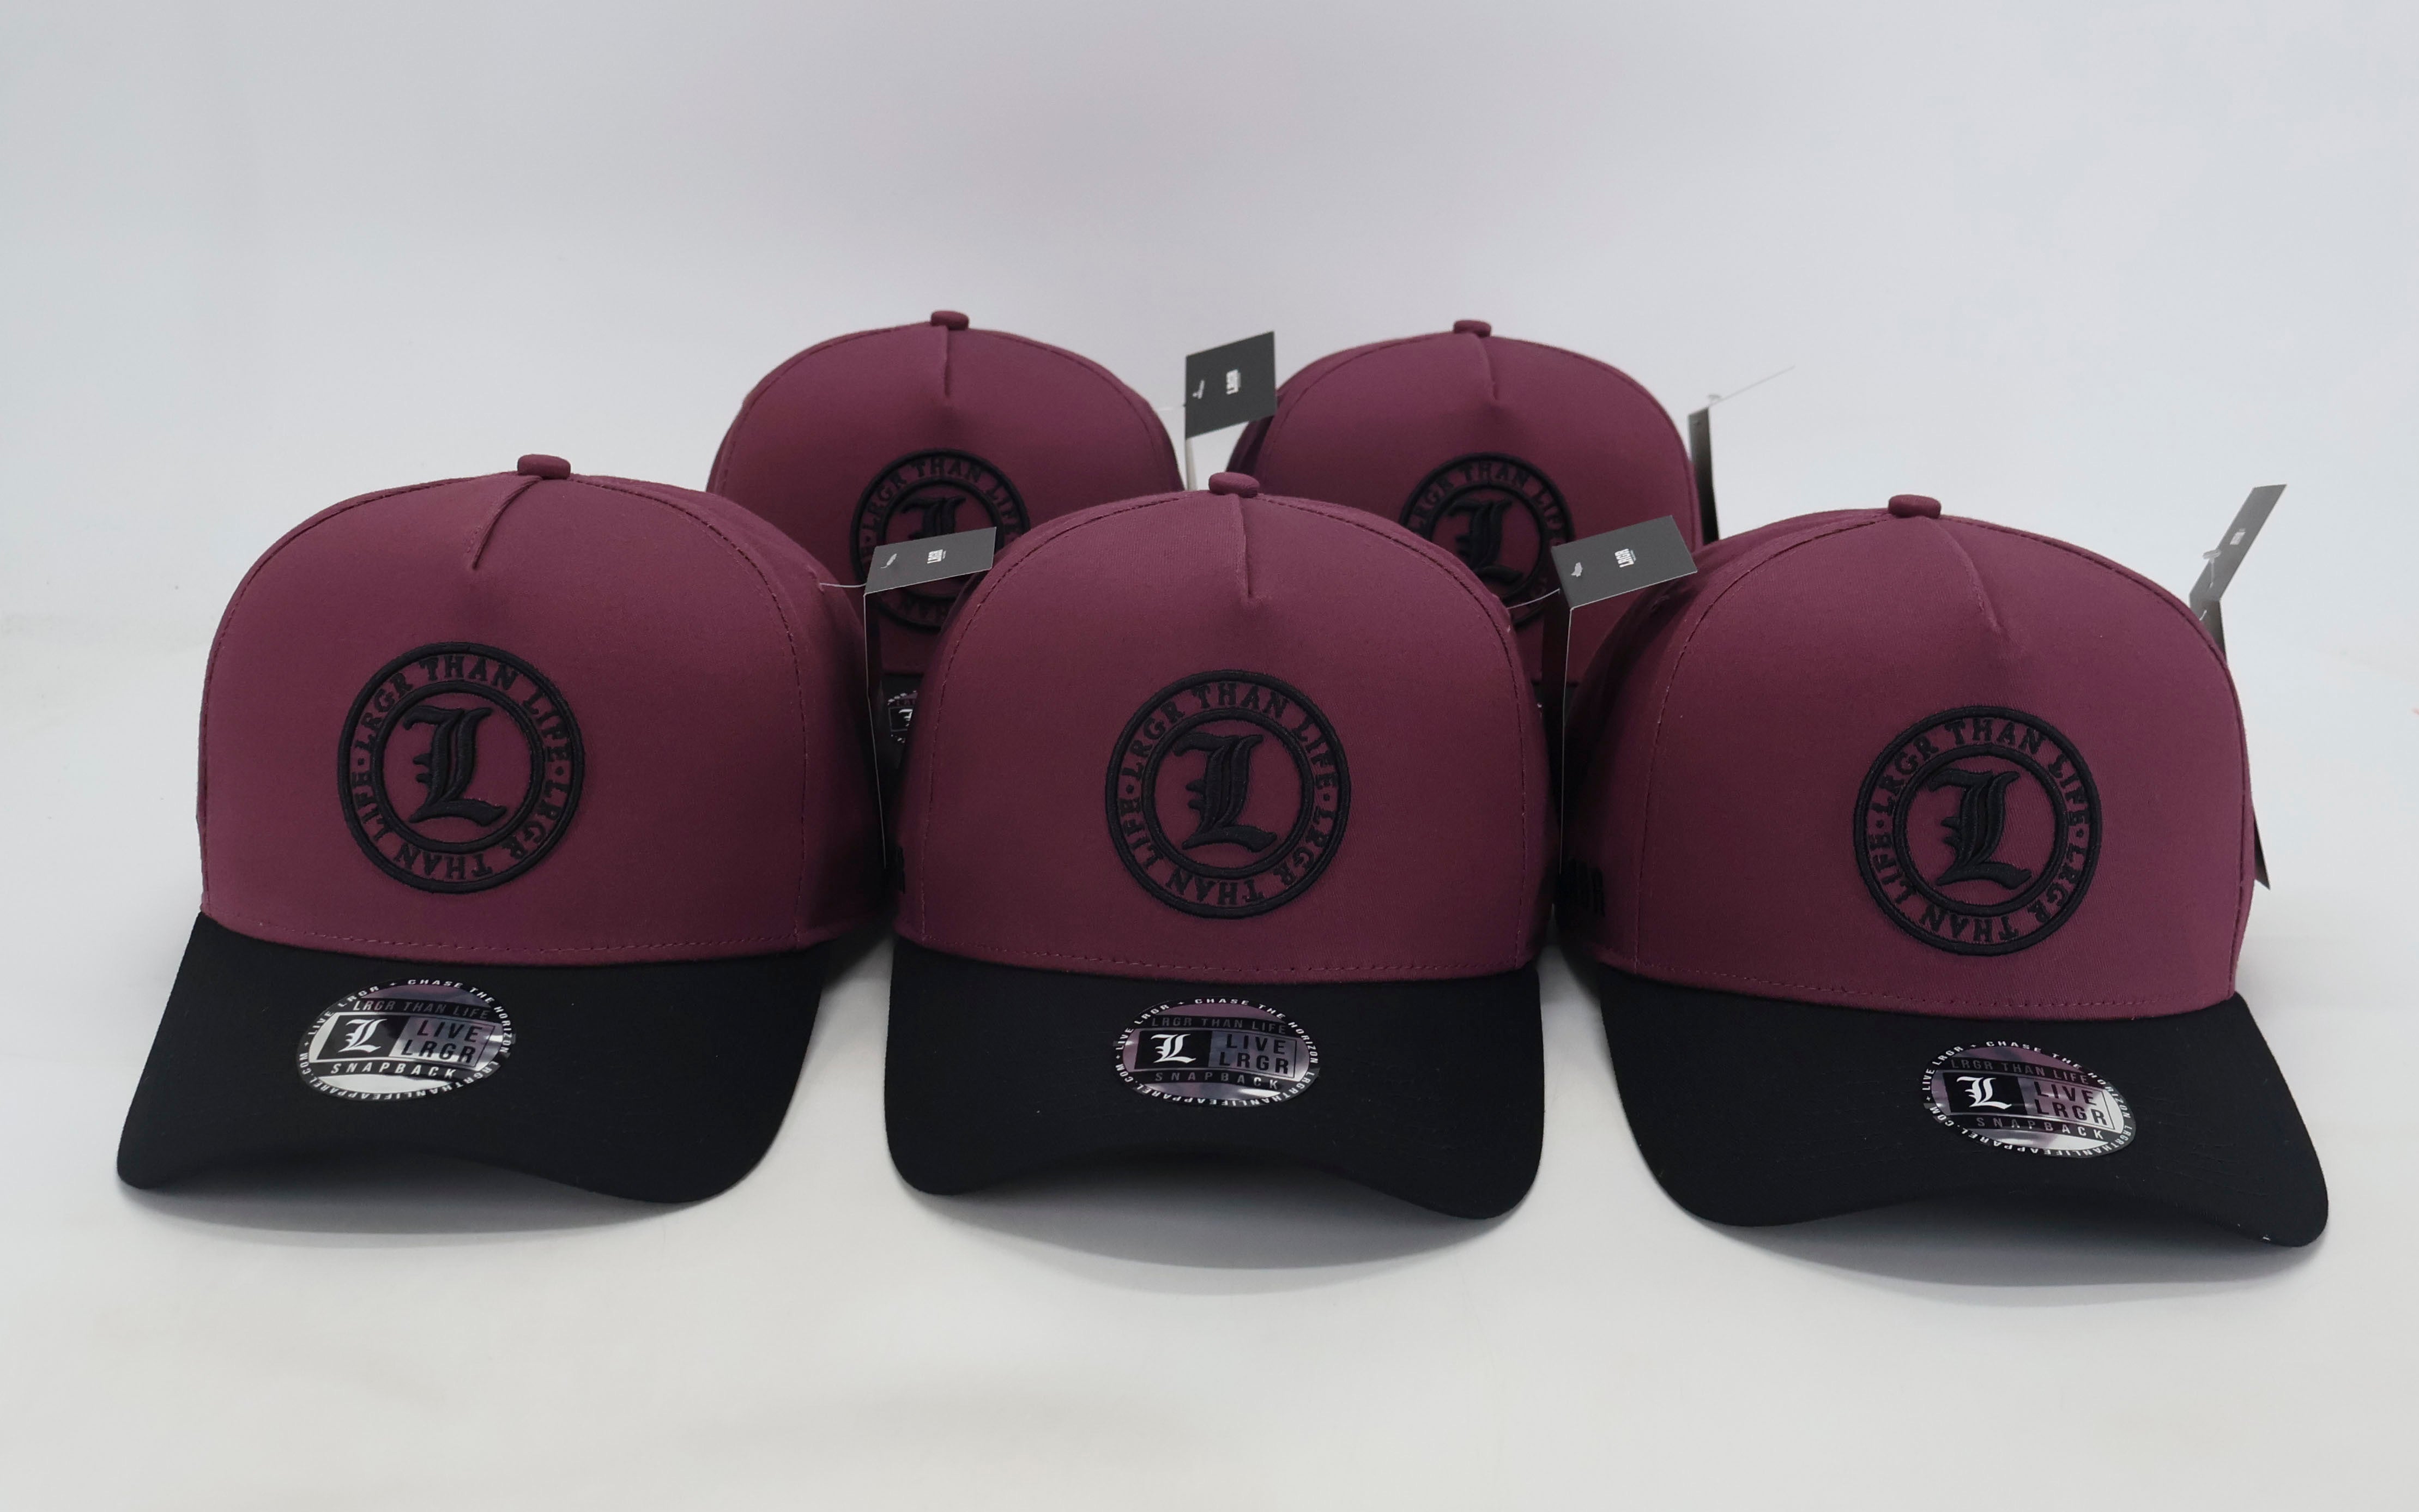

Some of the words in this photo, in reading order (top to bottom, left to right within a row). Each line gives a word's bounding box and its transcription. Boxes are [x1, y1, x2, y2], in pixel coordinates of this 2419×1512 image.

[911, 457, 983, 482] THAN
[1410, 476, 1455, 528] RGR
[1459, 461, 1529, 488] THAN
[355, 672, 413, 751] LRGR
[419, 655, 520, 691] THAN
[523, 683, 572, 762] LIFE
[1121, 700, 1186, 781] LRGR
[1193, 682, 1291, 717] THAN
[1292, 717, 1338, 789] LIFE
[402, 705, 507, 827] L
[1871, 735, 1939, 815] LRGR
[1945, 718, 2047, 754] THAN
[2048, 753, 2089, 826] LIFE
[352, 772, 394, 840] LIFE
[1172, 731, 1277, 852] L
[495, 779, 570, 860] LRGR
[1119, 797, 1163, 870] LIFE
[1927, 769, 2032, 890] L
[394, 843, 493, 879] THAN
[1273, 806, 1336, 886] LRGR
[1869, 833, 1915, 904] LIFE
[2027, 845, 2087, 923] LRGR
[1165, 870, 1265, 905] THAN
[1920, 904, 2018, 942] THAN
[308, 1012, 336, 1036] LIVE
[337, 985, 380, 1007] LRGR
[408, 979, 464, 988] CHASE
[470, 987, 495, 1003] THE
[493, 1006, 513, 1053] HORIZON
[352, 1000, 395, 1012] LRGR
[403, 1001, 446, 1014] THAN
[453, 1007, 491, 1020] LIFE
[1152, 1018, 1193, 1027] LRGR
[1201, 1018, 1243, 1029] THAN
[1251, 1021, 1287, 1034] LIFE
[338, 1018, 388, 1053] L
[417, 1020, 482, 1043] LIVE
[1115, 1028, 1134, 1050] LIVE
[1134, 1003, 1170, 1025] LRGR
[1258, 1004, 1286, 1019] THE
[1288, 1021, 1319, 1064] HORIZON
[1150, 1033, 1196, 1064] L
[1226, 1033, 1287, 1055] LIVE
[401, 1039, 476, 1063] LRGR
[1219, 1051, 1289, 1074] LRGR
[330, 1063, 456, 1078] SNAPBACK
[1154, 1072, 1278, 1090] SNAPBACK
[1922, 1068, 1935, 1090] LIVE
[1932, 1046, 1963, 1066] LRGR
[1986, 1041, 2041, 1052] CHASE
[2052, 1053, 2082, 1068] THE
[2088, 1072, 2131, 1118] HORIZON
[1951, 1059, 1993, 1070] LRGR
[2001, 1062, 2046, 1076] THAN
[2054, 1071, 2089, 1084] LIFE
[1956, 1076, 2012, 1109] L
[2034, 1082, 2097, 1105] LIVE
[1977, 1117, 2103, 1140] SNAPBACK
[2034, 1099, 2107, 1126] LRGR
